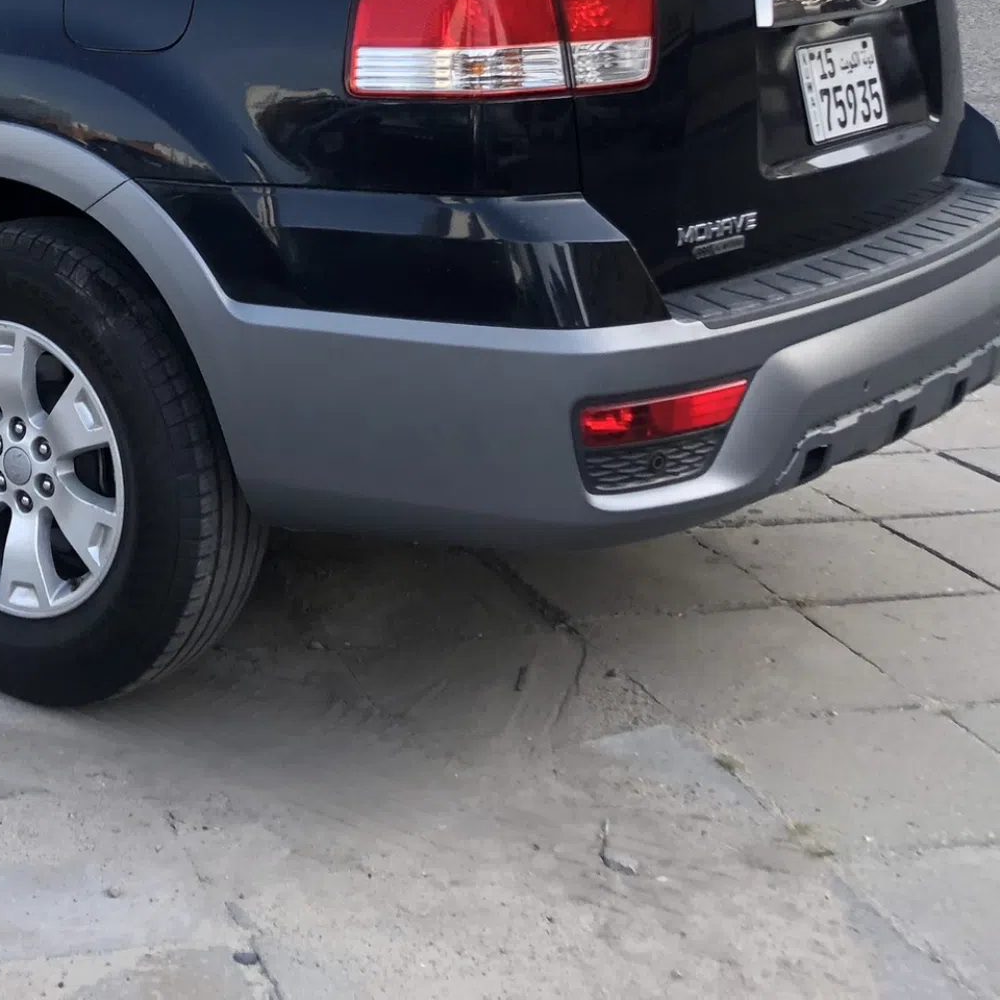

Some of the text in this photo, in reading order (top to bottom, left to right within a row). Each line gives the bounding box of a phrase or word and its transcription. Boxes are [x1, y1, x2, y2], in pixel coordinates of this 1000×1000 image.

[817, 47, 836, 80] 15
[819, 77, 883, 132] 75935
[677, 212, 757, 247] MOHAVE
